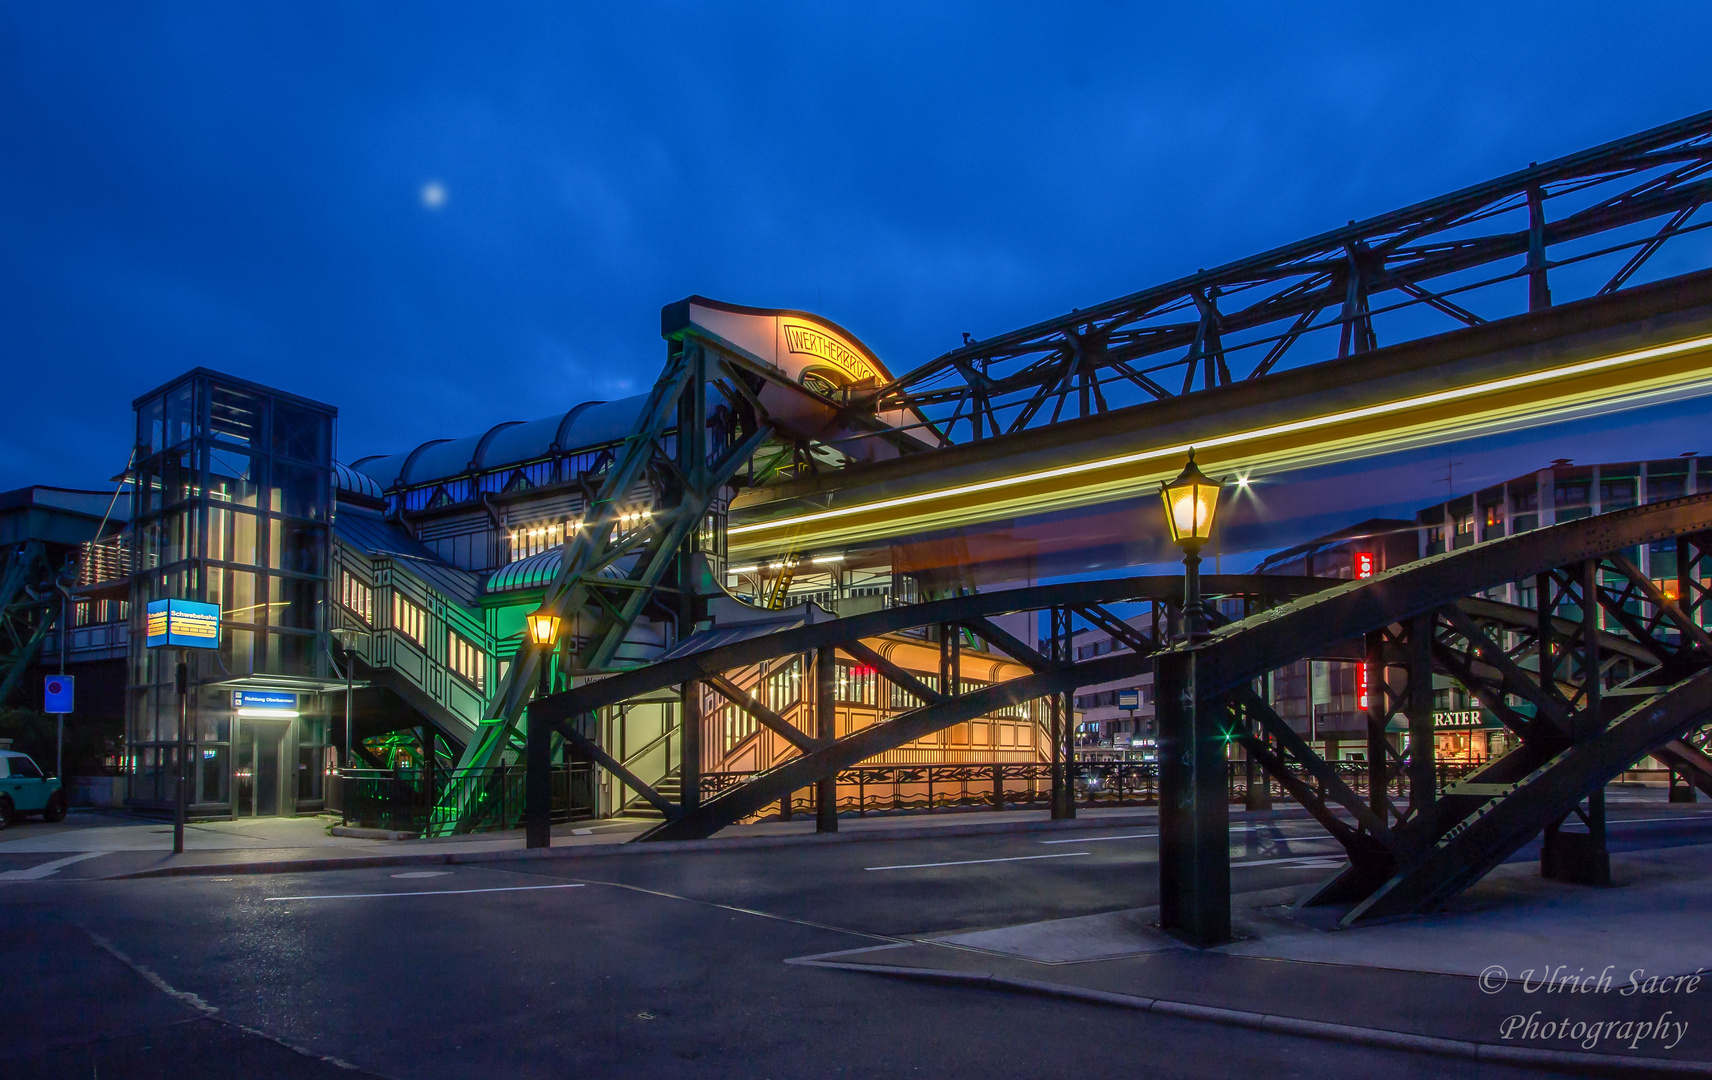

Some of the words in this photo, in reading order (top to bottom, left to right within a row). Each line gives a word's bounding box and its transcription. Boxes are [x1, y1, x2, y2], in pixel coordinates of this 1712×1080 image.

[791, 330, 873, 379] WERTHERBRÜC
[171, 609, 218, 621] Schwebebahn
[1432, 711, 1482, 727] RÄTER
